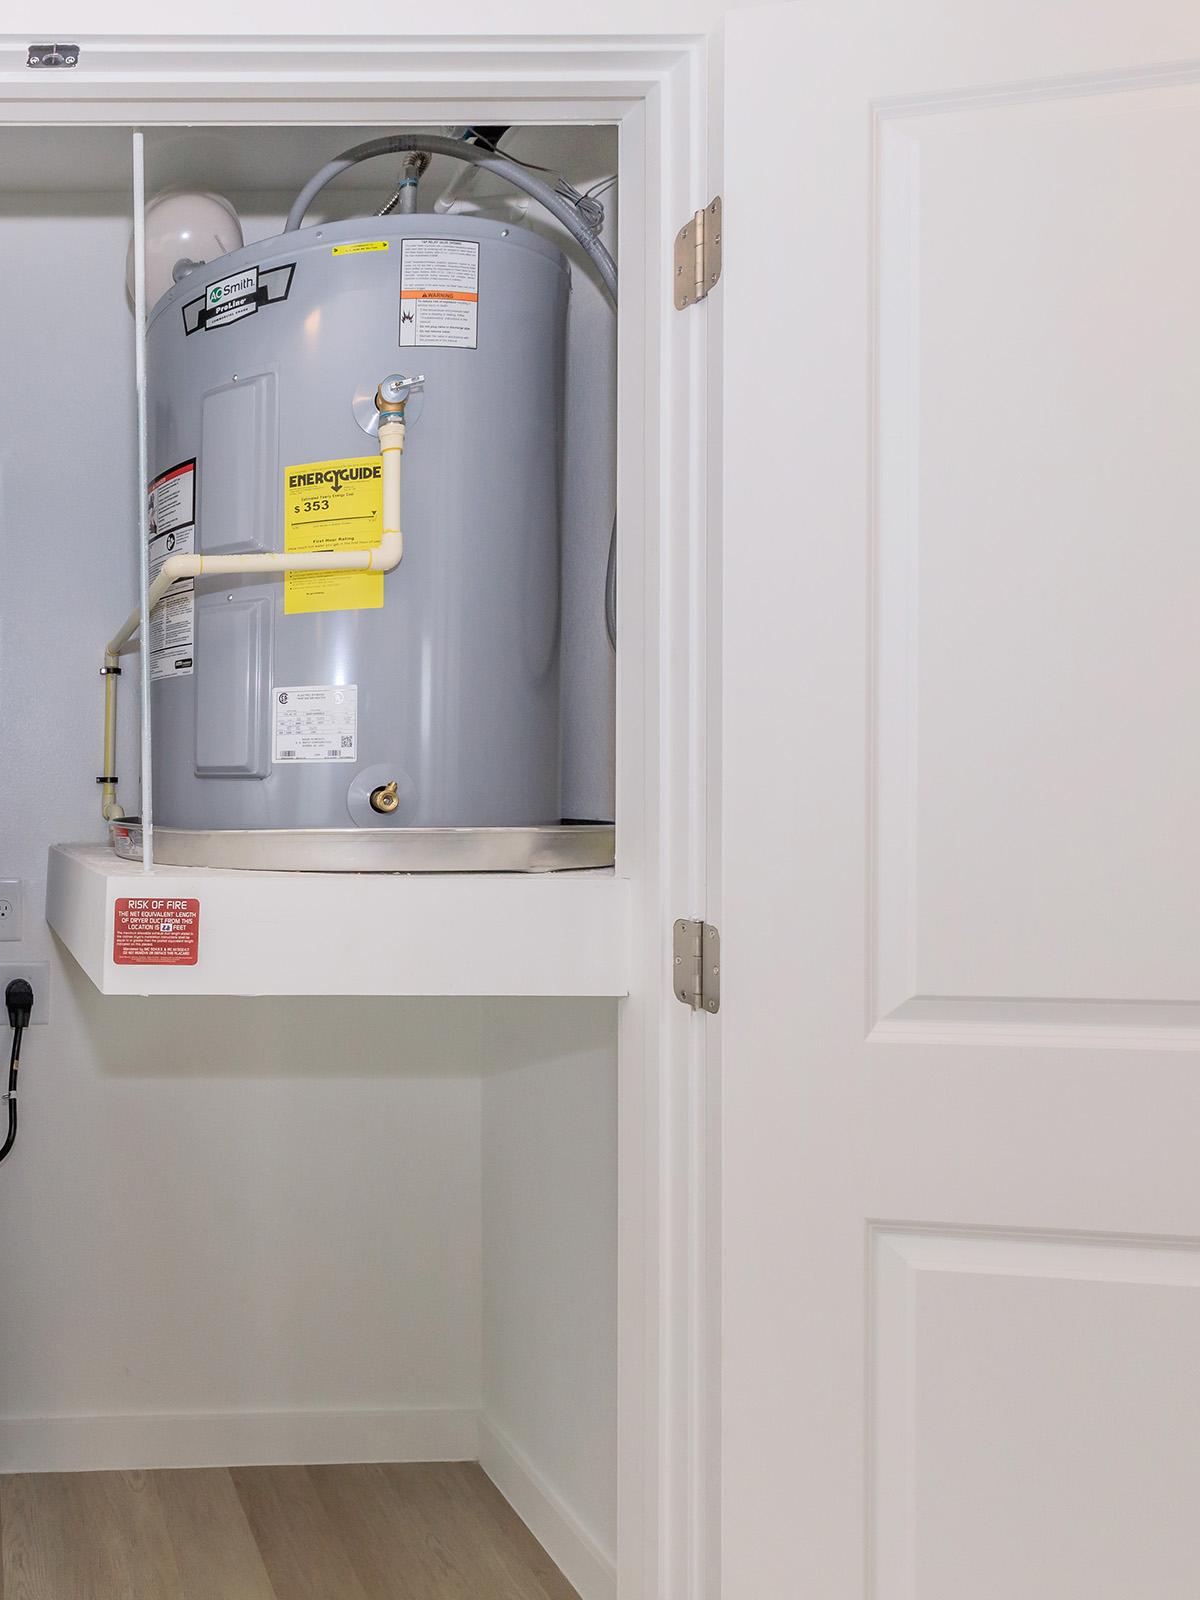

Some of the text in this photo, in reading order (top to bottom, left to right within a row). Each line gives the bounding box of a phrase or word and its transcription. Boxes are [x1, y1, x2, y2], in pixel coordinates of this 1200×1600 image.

[223, 277, 254, 296] Smith
[215, 298, 247, 314] ProLine
[304, 499, 330, 512] 353
[128, 900, 188, 910] RISK OF FIRE
